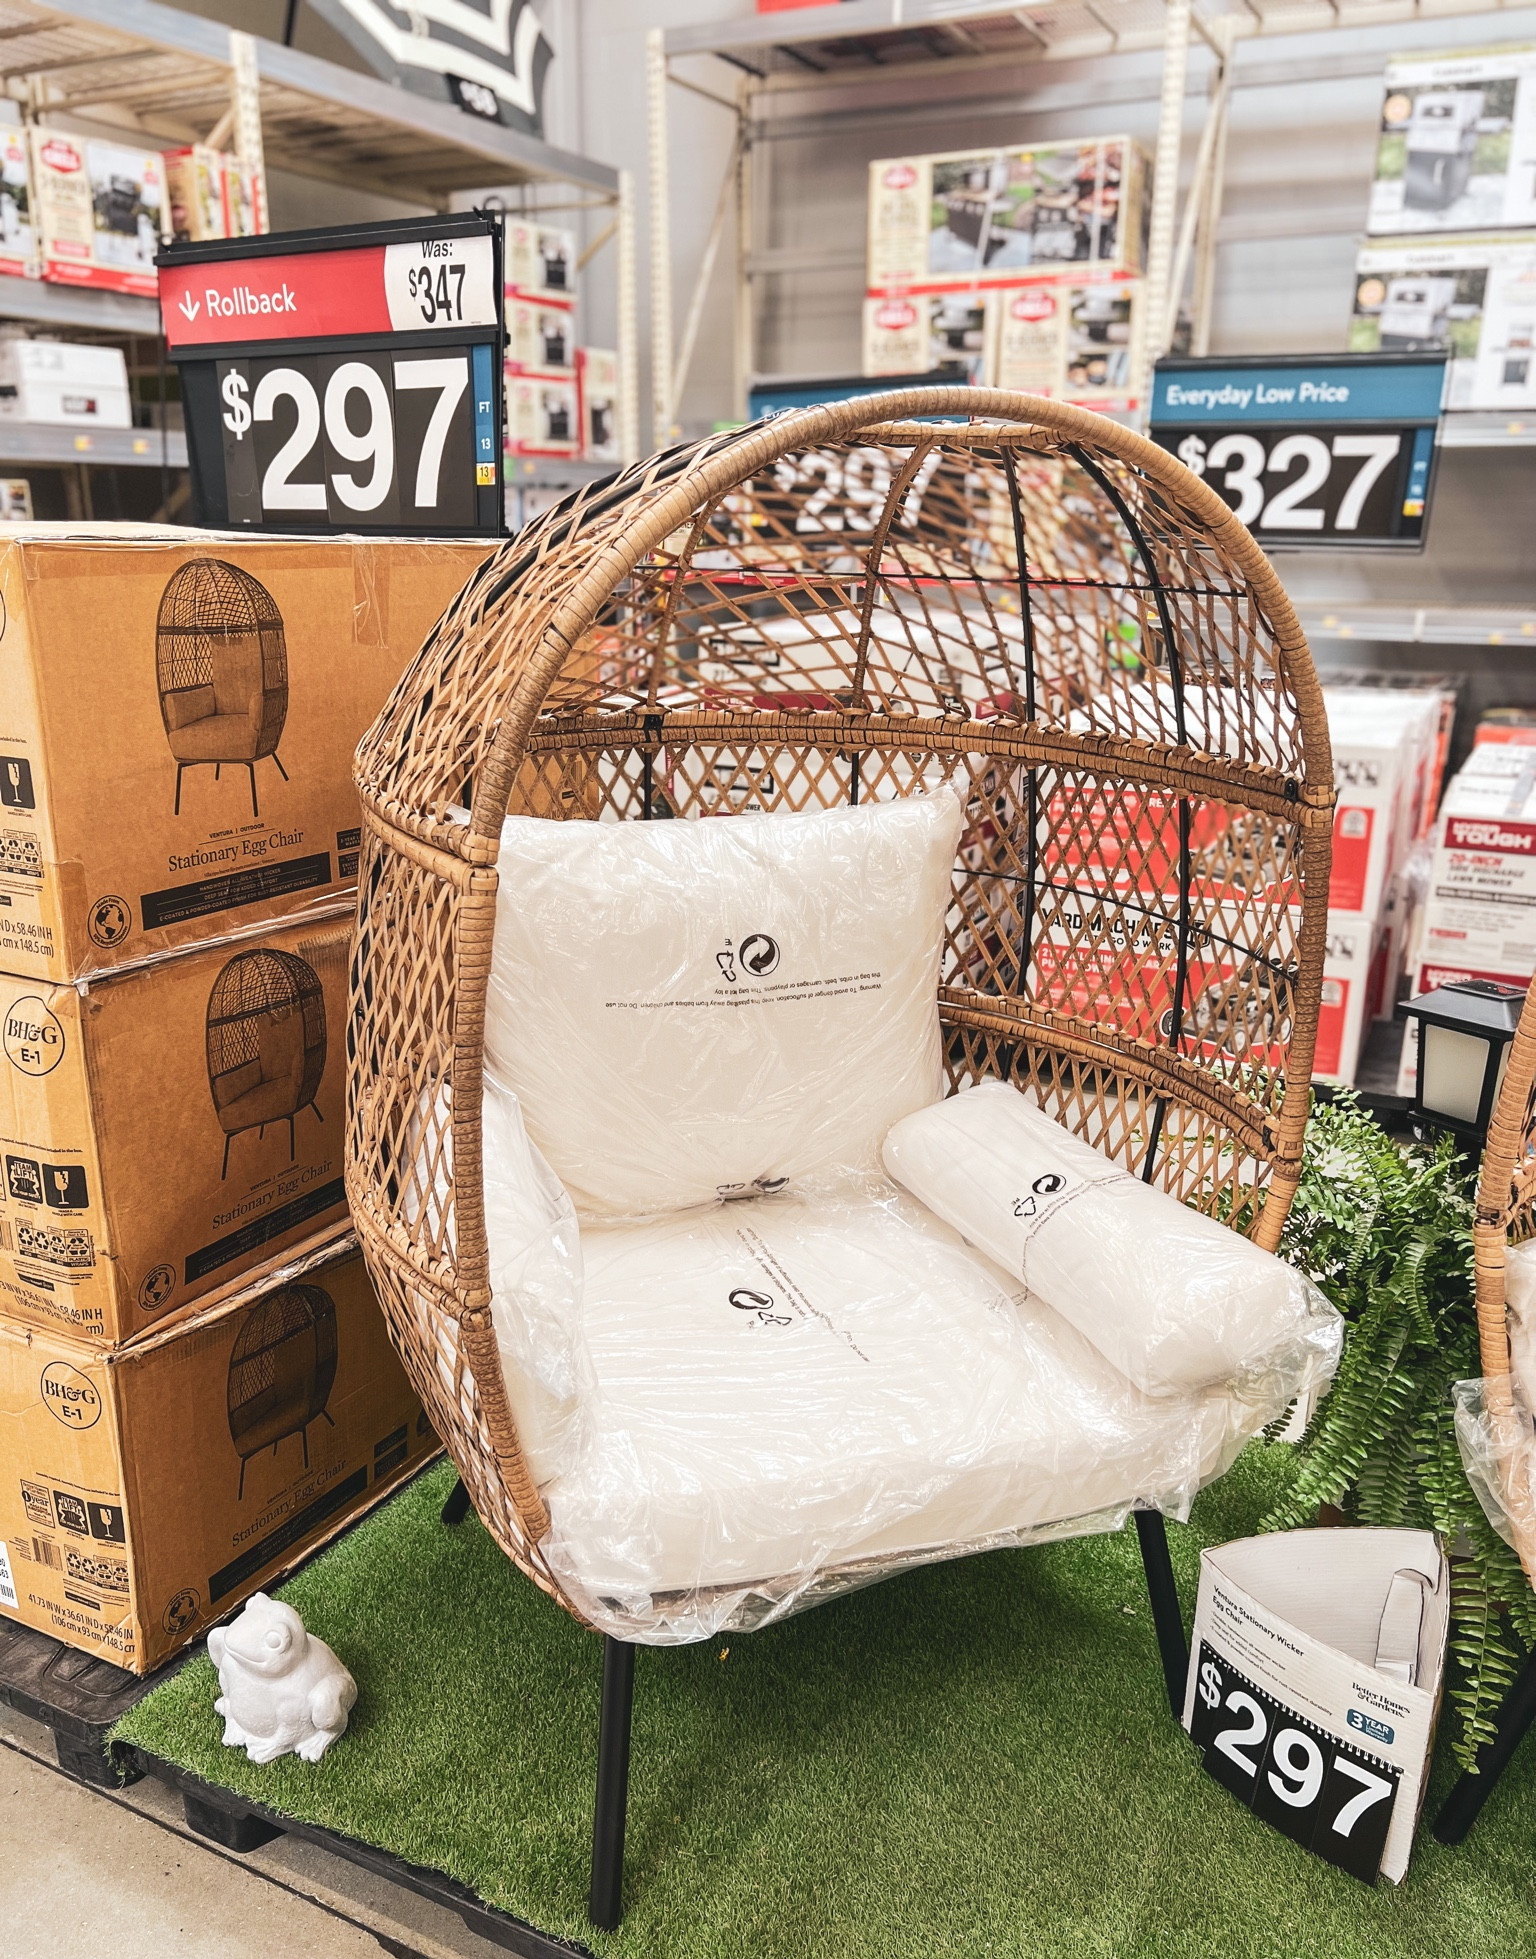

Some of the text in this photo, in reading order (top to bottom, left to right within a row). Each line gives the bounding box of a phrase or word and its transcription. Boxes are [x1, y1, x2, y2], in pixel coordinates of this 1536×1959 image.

[421, 240, 453, 258] Was:
[206, 283, 297, 318] Rollback
[408, 263, 466, 324] $347
[1166, 381, 1350, 410] Everyday Low Price
[479, 401, 490, 414] FT
[222, 357, 469, 512] $297
[480, 438, 491, 450] 13
[479, 466, 489, 478] 13
[1178, 434, 1401, 530] $327
[209, 822, 265, 839] VENTURA OUTDOOR
[1455, 830, 1532, 849] TOUGH
[168, 845, 240, 872] Stationary
[241, 839, 267, 857] Egg
[269, 828, 304, 849] Chair
[4, 920, 11, 932] D
[16, 922, 37, 938] 58.46
[37, 927, 46, 939] IN
[46, 927, 53, 940] H
[2, 937, 14, 949] cm
[20, 938, 40, 954] 148.5
[40, 944, 54, 958] cm)
[859, 973, 871, 981] bag
[738, 987, 750, 995] bag
[815, 989, 834, 997] danger
[834, 988, 849, 996] avoid
[7, 1018, 58, 1045] BH&G
[21, 1048, 41, 1065] E-1
[212, 1160, 333, 1230] Stationary Egg Chair
[81, 1308, 103, 1320] IN H
[45, 1379, 96, 1405] BH&G
[62, 1404, 83, 1420] E-1
[31, 1496, 49, 1507] year
[231, 1458, 347, 1548] Stationary Egg Chair
[28, 1593, 46, 1608] 41.73
[46, 1599, 53, 1611] IN
[53, 1603, 61, 1614] W
[62, 1608, 66, 1616] x
[66, 1608, 84, 1624] 36.61
[85, 1615, 93, 1627] IN
[93, 1618, 99, 1629] D
[104, 1623, 123, 1638] 58.46
[123, 1628, 133, 1640] IN
[1212, 1595, 1243, 1626] Egg Chair
[1214, 1584, 1305, 1657] Ventura Stationary Wicker
[51, 1614, 66, 1627] (106
[67, 1621, 77, 1632] cm
[82, 1626, 90, 1637] 93
[91, 1630, 101, 1640] cm
[106, 1636, 123, 1651] 148.5
[1235, 1639, 1248, 1652] added
[1271, 1659, 1286, 1671] wicker
[1352, 1682, 1411, 1714] Better Homes
[1357, 1691, 1366, 1699] &
[1309, 1700, 1333, 1716] durability
[1351, 1712, 1390, 1735] 3 YEAR
[1199, 1661, 1393, 1839] $297
